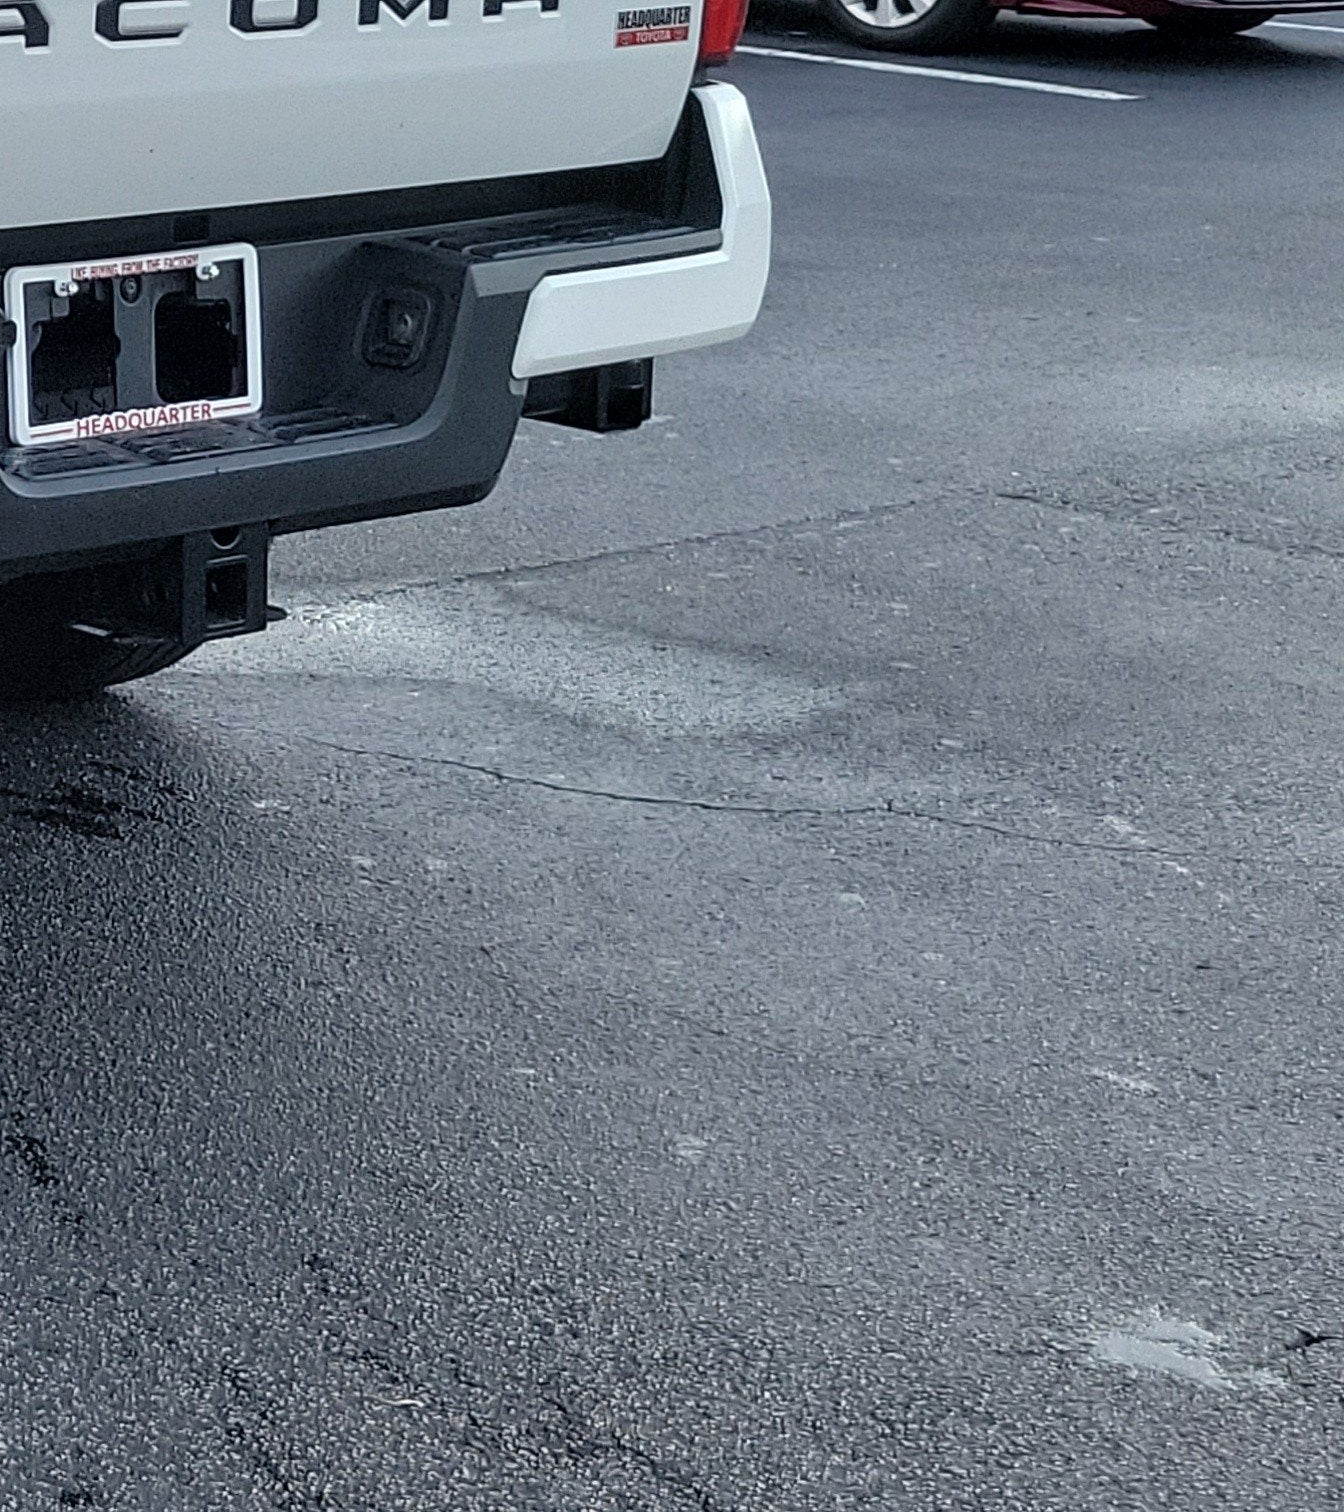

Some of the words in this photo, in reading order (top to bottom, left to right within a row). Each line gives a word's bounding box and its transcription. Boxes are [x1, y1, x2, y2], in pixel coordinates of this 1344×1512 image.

[616, 5, 691, 30] HEADQUARTER
[636, 30, 671, 43] TOYOTA
[77, 402, 212, 437] HEADQUARTER
